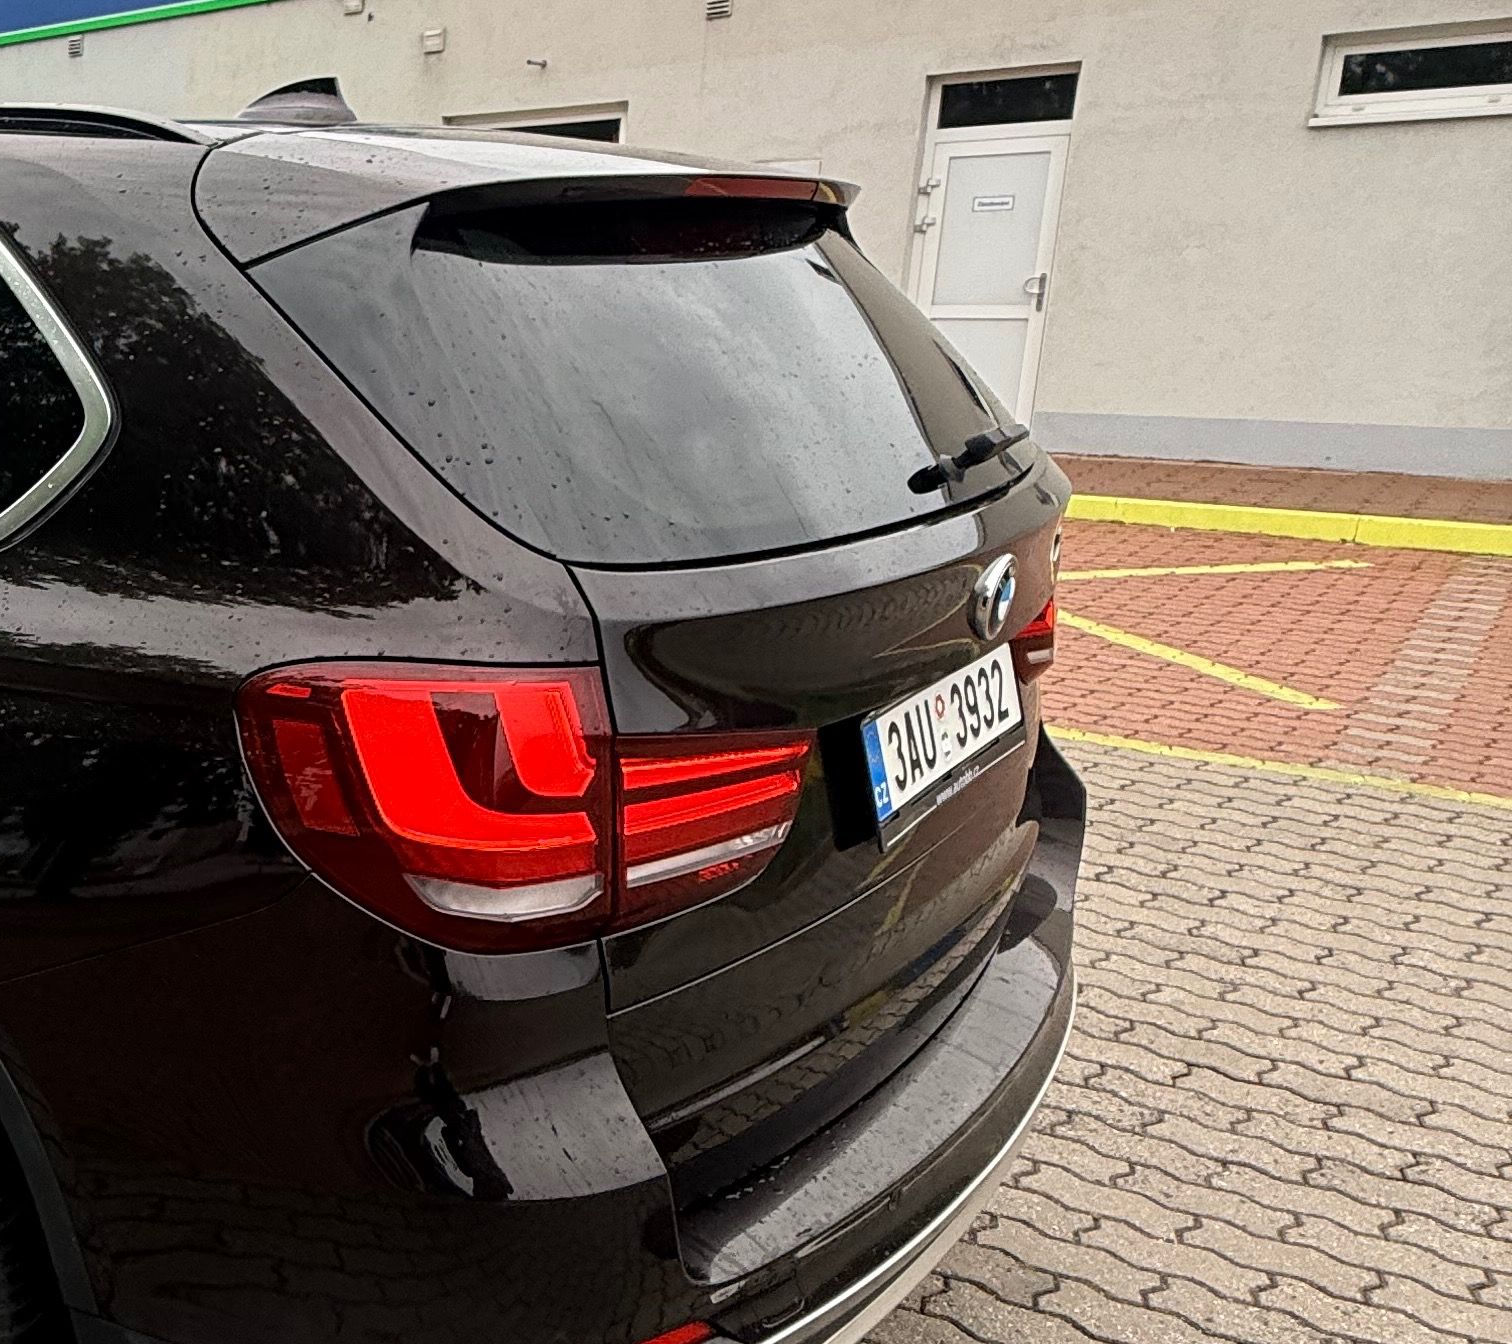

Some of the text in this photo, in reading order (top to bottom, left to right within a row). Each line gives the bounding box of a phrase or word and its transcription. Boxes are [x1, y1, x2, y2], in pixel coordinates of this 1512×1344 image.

[888, 659, 1009, 792] 3AU 3932
[874, 781, 889, 808] CZ
